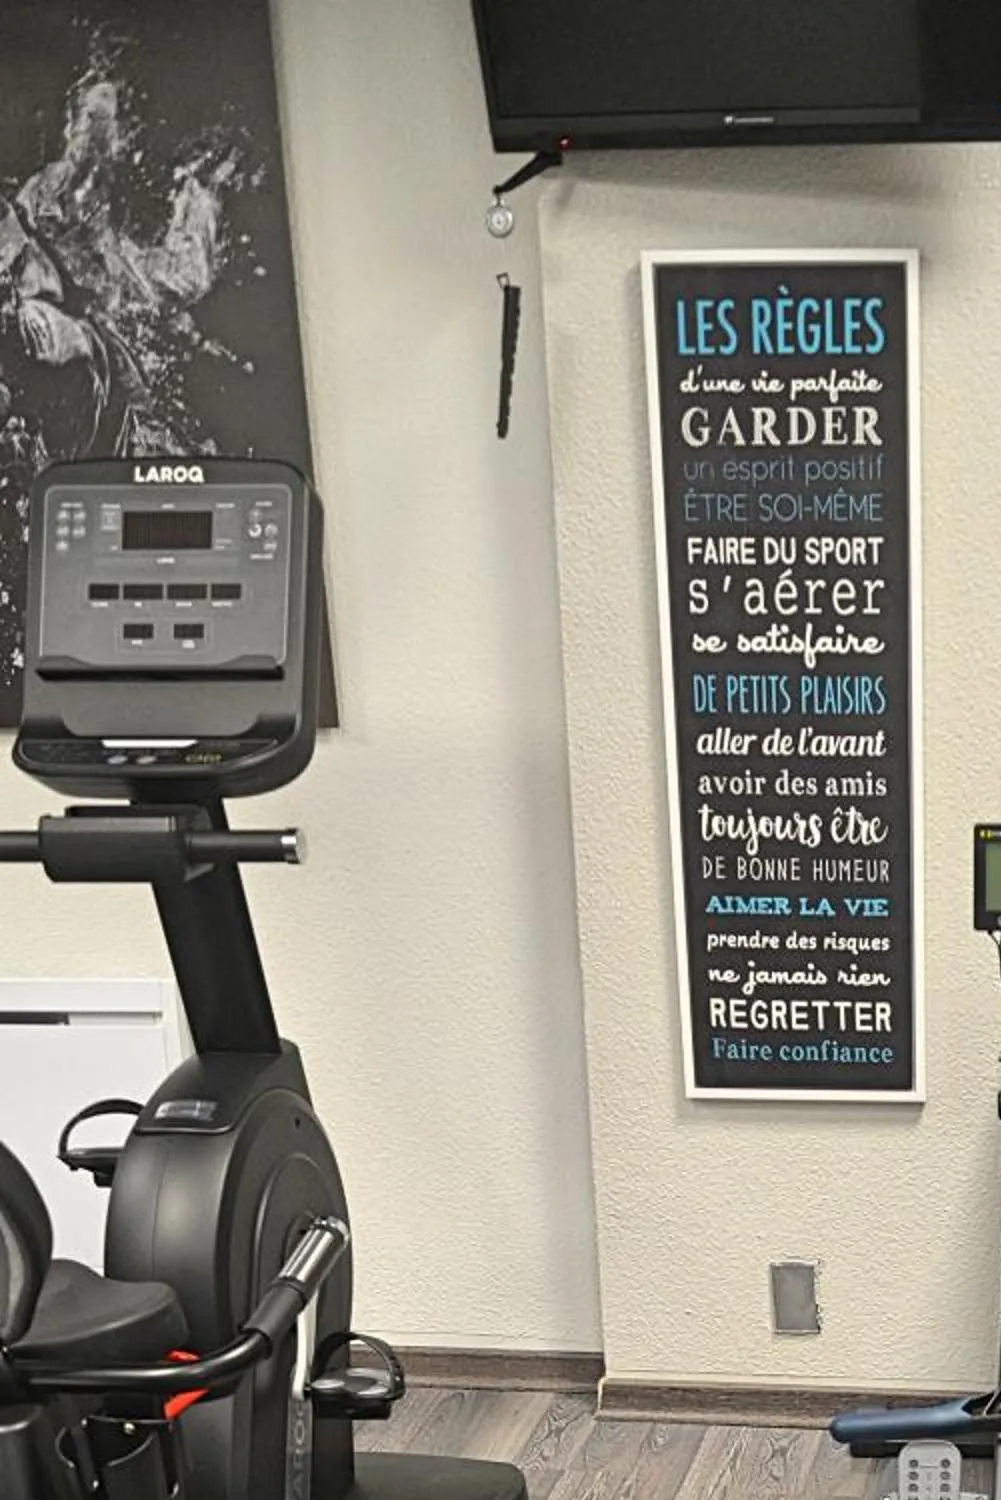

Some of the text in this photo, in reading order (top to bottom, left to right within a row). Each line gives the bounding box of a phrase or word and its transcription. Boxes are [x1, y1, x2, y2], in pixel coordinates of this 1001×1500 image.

[677, 285, 885, 355] LES RÈGLES
[679, 365, 883, 403] d'une vie parfaite
[680, 406, 883, 446] GARDER
[134, 466, 204, 483] LAROQ
[683, 454, 884, 485] un esprit positif
[684, 487, 884, 523] ÊTRE SOI-MÊME
[687, 537, 884, 565] FAIRE DU SPORT
[689, 570, 885, 615] s'aérer
[692, 622, 884, 669] se satisfaire
[693, 674, 885, 716] DE PETITS PLAISIRS
[697, 728, 886, 757] aller de l'avant
[699, 769, 886, 797] avoir des amis
[698, 804, 889, 855] toujours être
[703, 855, 889, 883] DE BONNE HUMEUR
[706, 896, 889, 917] AIMER LA VIE
[707, 930, 890, 955] prendre des risques
[708, 960, 890, 994] ne jamais rien
[709, 998, 891, 1032] REGRETTER
[712, 1037, 893, 1064] Faire confiance
